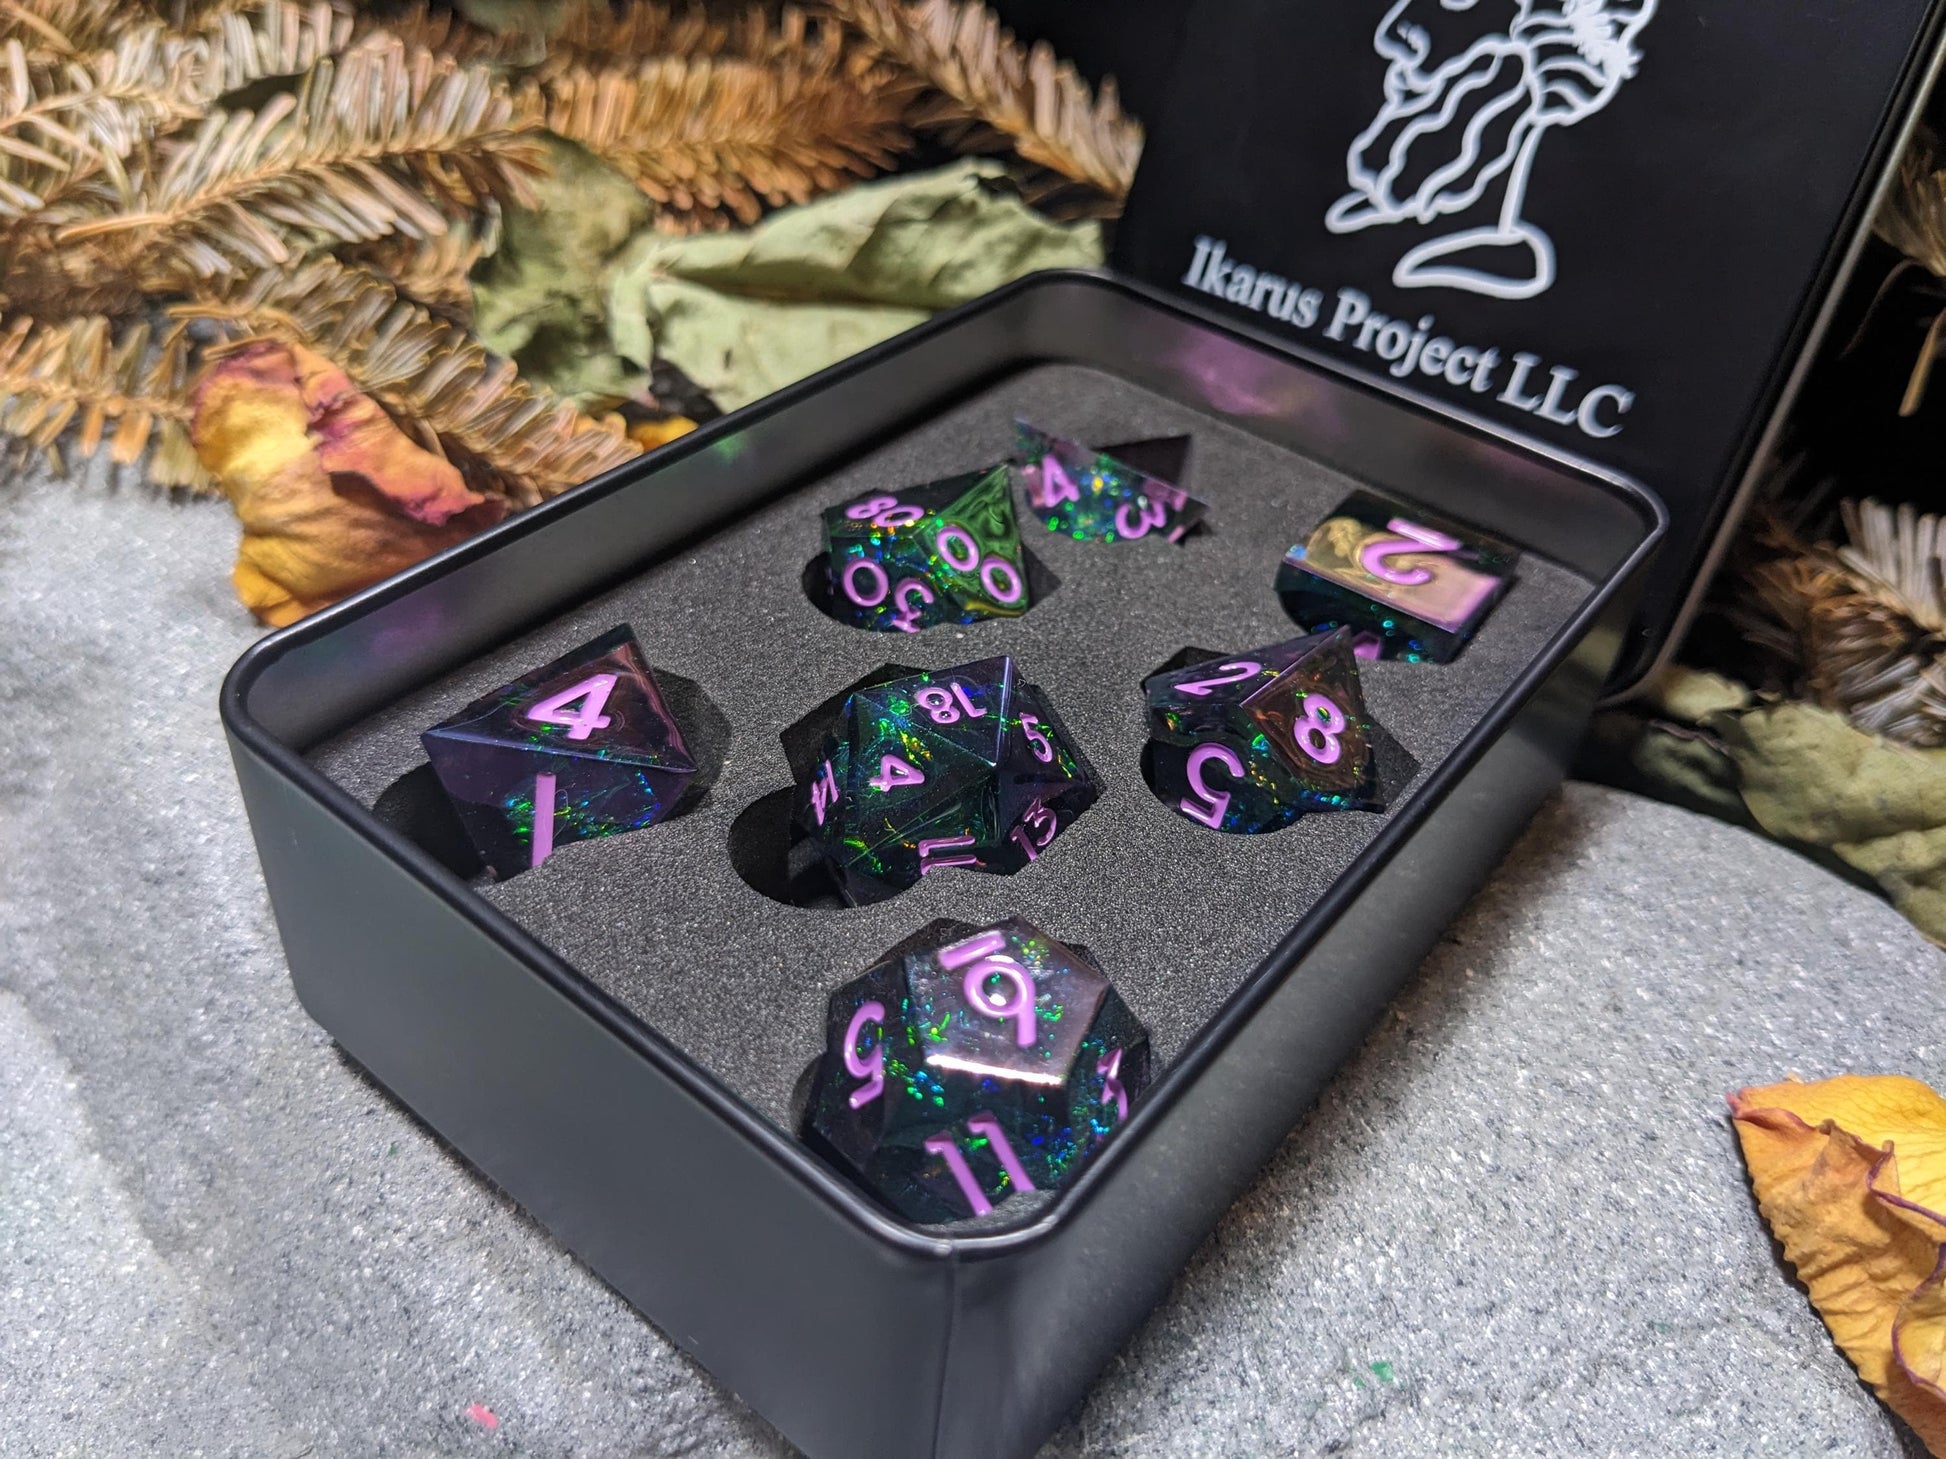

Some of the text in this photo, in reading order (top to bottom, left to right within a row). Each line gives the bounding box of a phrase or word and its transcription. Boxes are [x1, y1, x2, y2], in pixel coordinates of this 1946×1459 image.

[1181, 234, 1635, 438] Ikarus Project LLC
[1040, 454, 1079, 508] 4
[845, 496, 925, 528] 80
[1115, 497, 1167, 539] 3
[936, 525, 1022, 603] 00
[914, 682, 987, 724] 18
[1173, 661, 1262, 696] 2
[527, 673, 619, 740] 4
[1294, 693, 1346, 765] 8
[1019, 712, 1053, 763] 5
[870, 754, 926, 792] 4
[1180, 742, 1245, 830] 5
